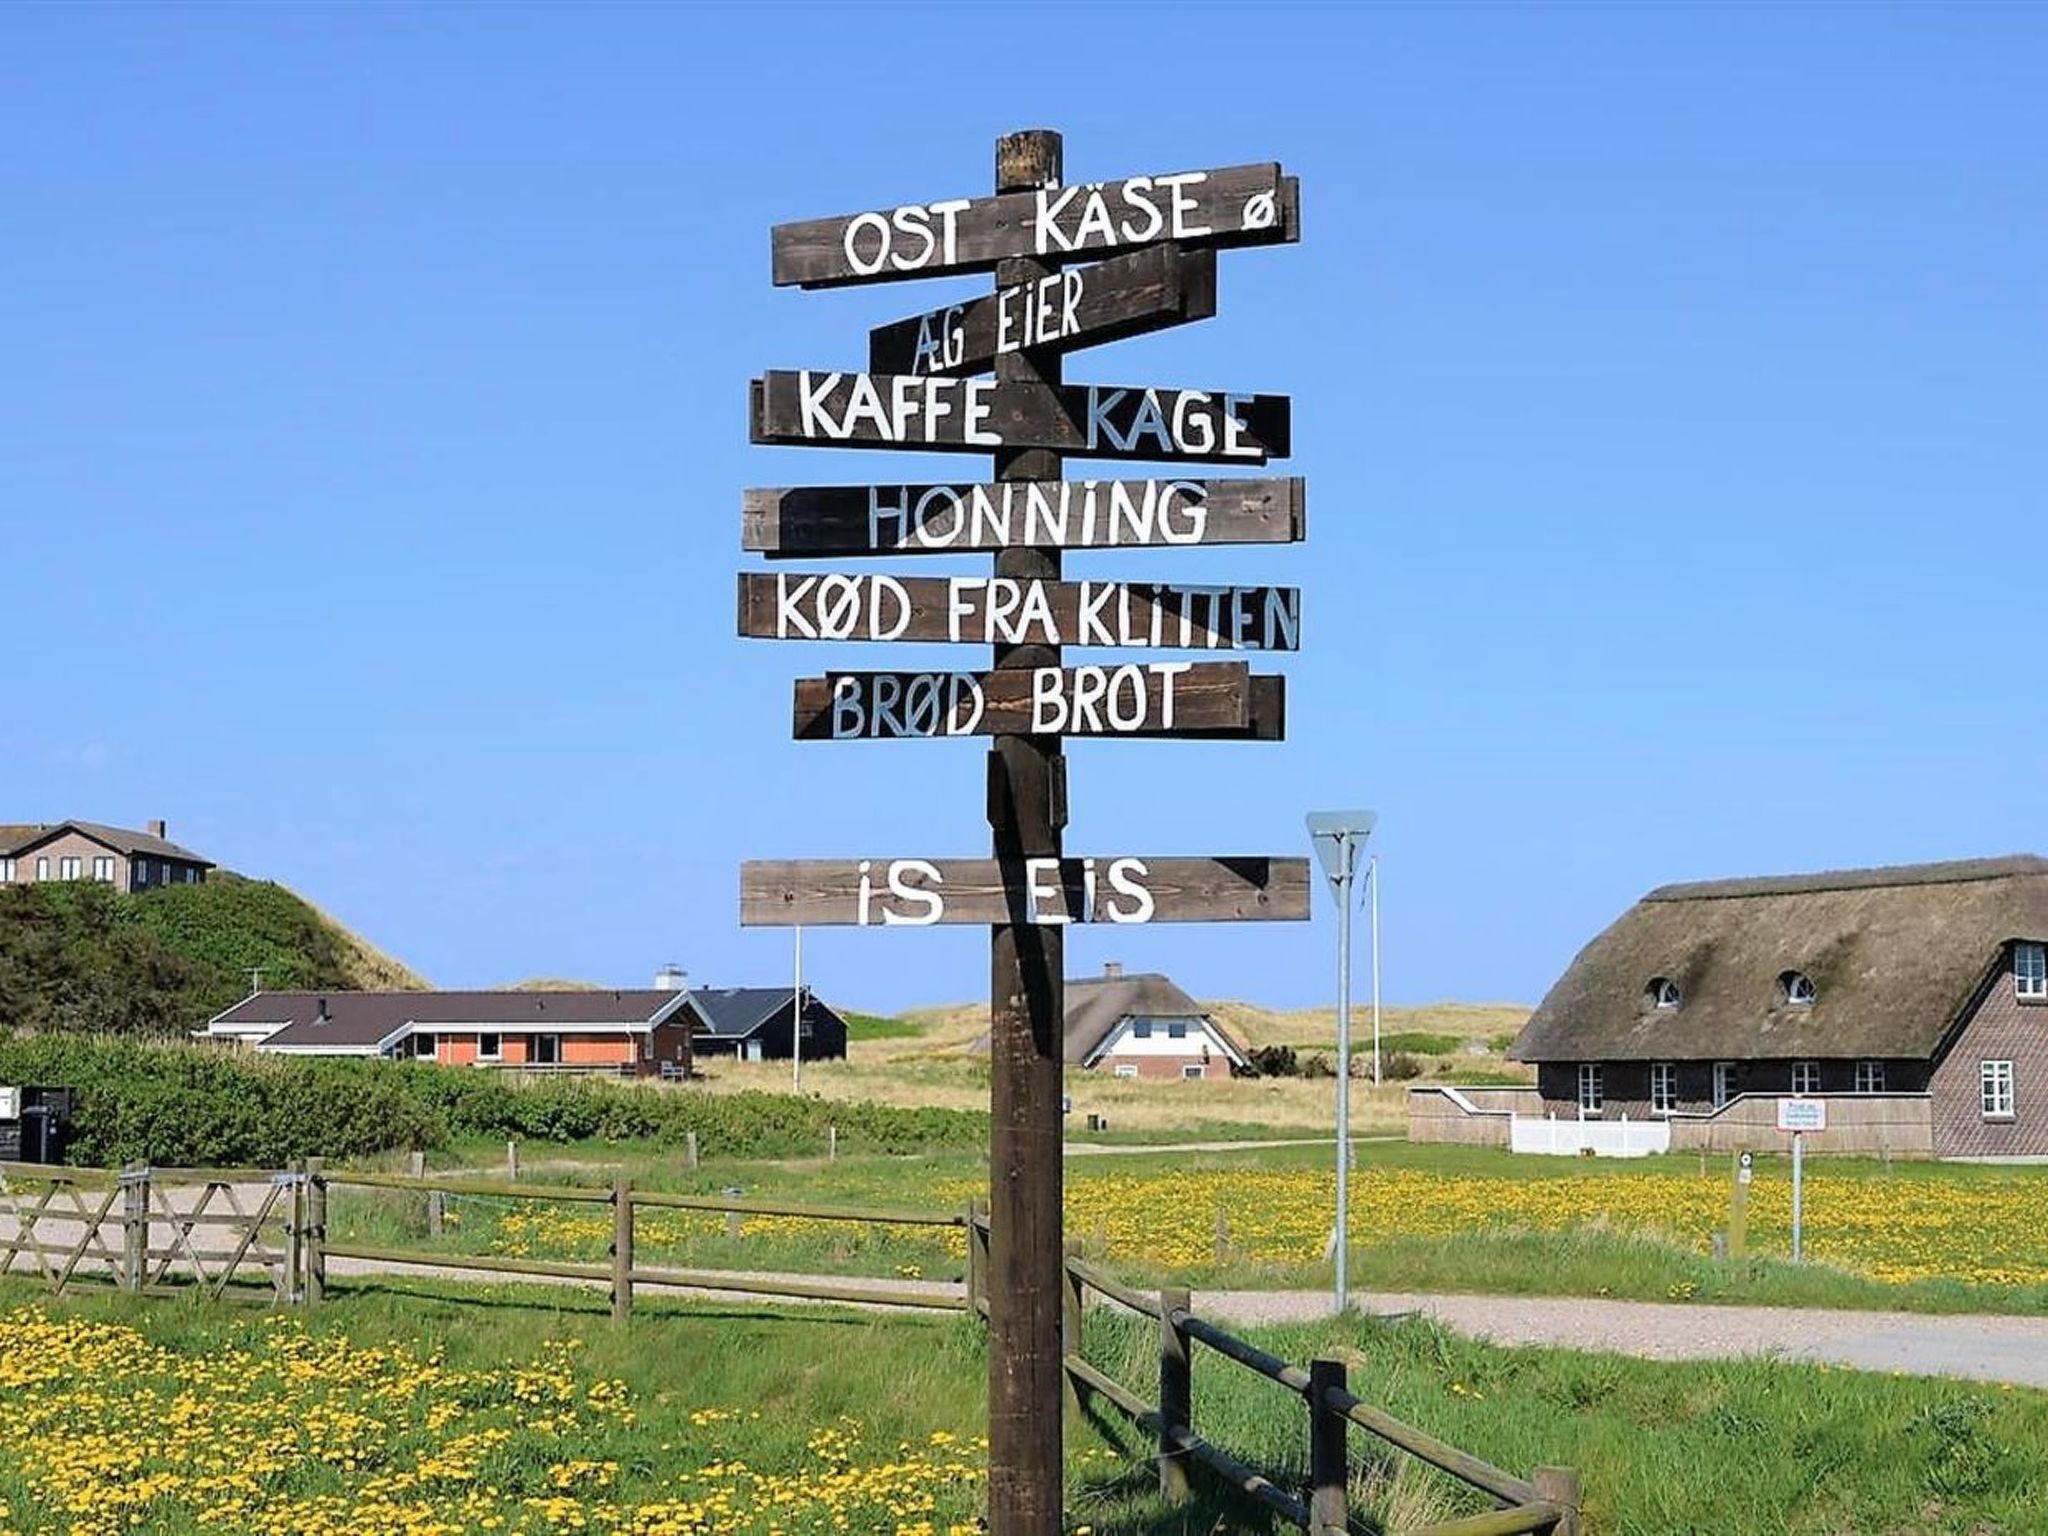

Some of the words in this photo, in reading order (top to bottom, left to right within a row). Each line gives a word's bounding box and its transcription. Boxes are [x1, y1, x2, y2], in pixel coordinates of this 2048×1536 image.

[843, 200, 971, 275] OST
[1034, 171, 1212, 255] KÄSE
[912, 306, 965, 375] ÆG
[799, 371, 1003, 446] KAFFE
[1086, 386, 1264, 458] KAGE
[776, 573, 911, 640] KØD
[948, 577, 1060, 644] FRA
[832, 671, 985, 739] BRØD
[1031, 661, 1192, 734] BROT
